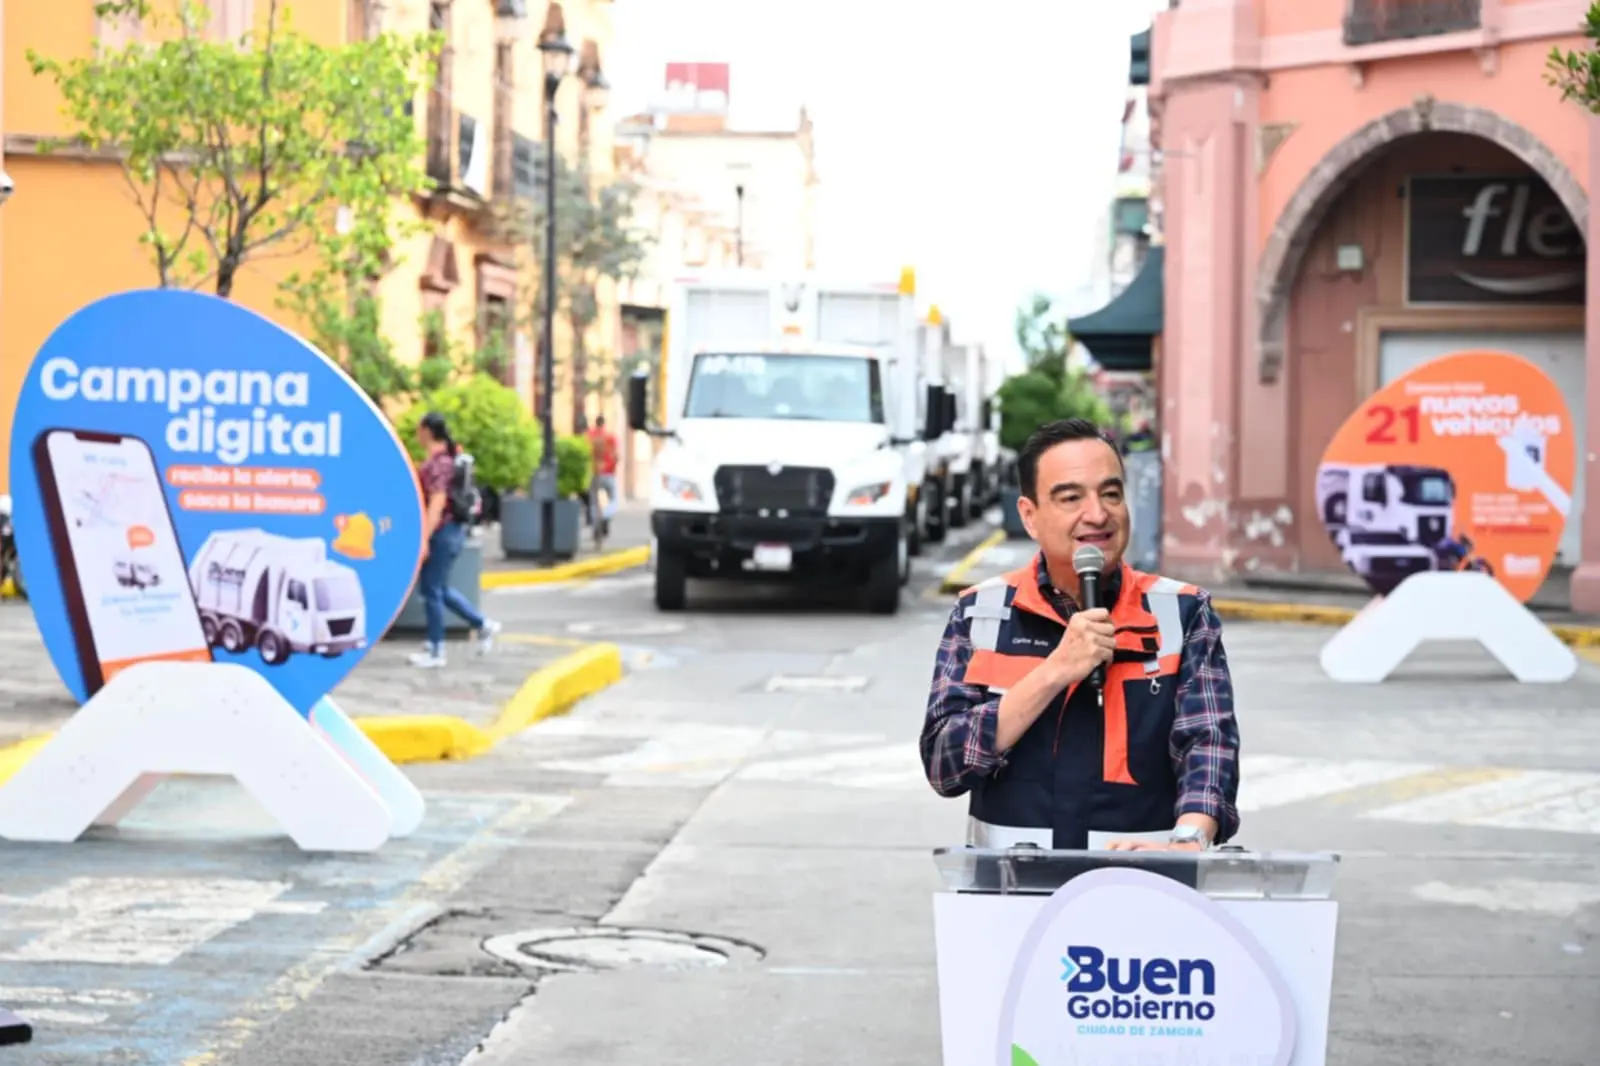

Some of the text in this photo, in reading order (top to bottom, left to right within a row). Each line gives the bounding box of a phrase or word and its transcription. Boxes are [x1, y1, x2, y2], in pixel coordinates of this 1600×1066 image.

[1462, 182, 1586, 256] fle
[40, 357, 309, 413] Campana
[1420, 395, 1519, 416] nuevos
[165, 408, 341, 464] digital
[1366, 404, 1420, 444] 21
[171, 466, 230, 485] recibe
[233, 468, 252, 485] la
[183, 493, 321, 512] saca la basura
[1067, 945, 1216, 996] Buen
[1067, 995, 1216, 1021] Gobierno
[1077, 1024, 1204, 1037] CIUDAD DE ZAMORA
